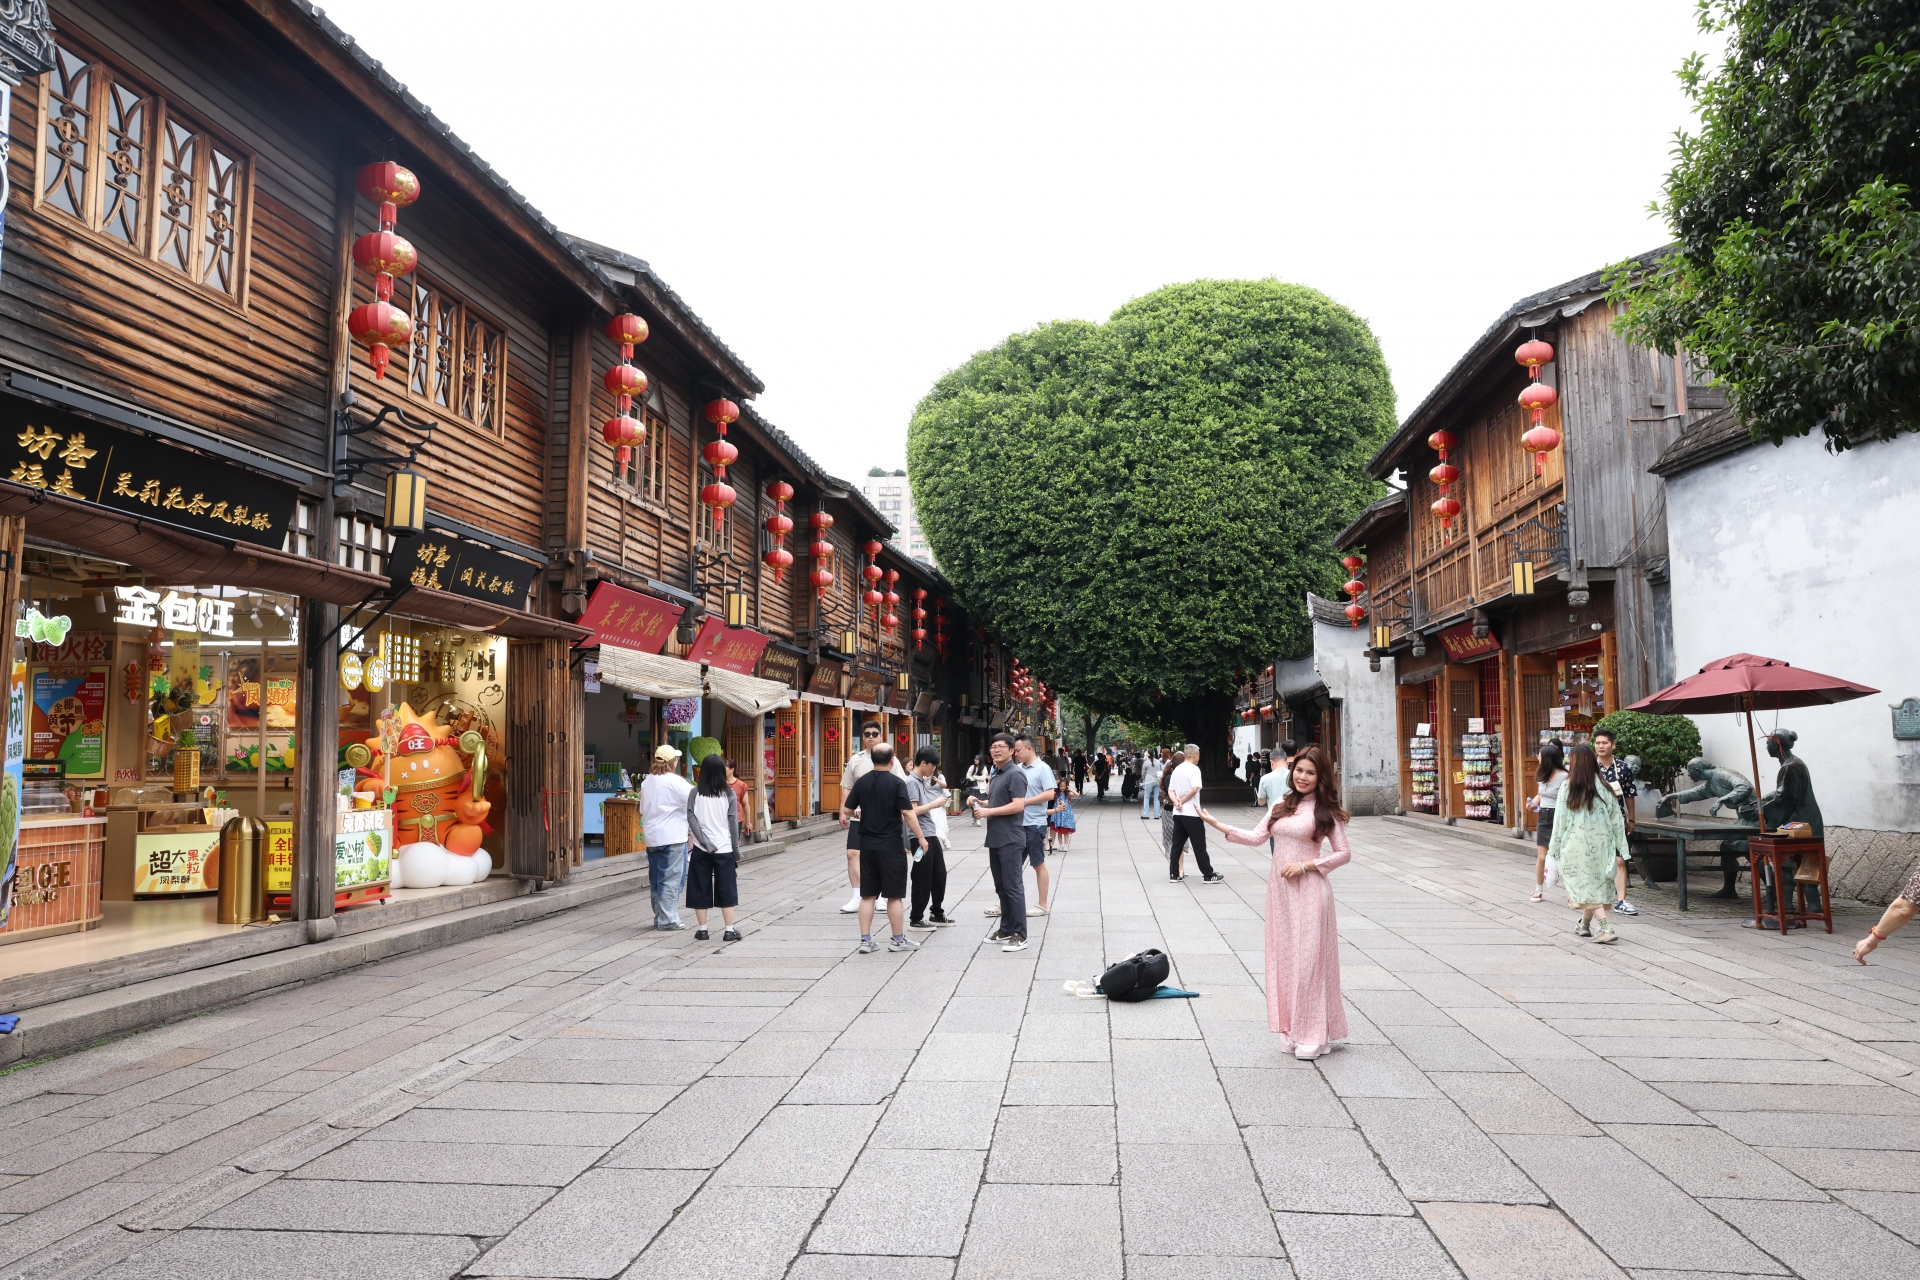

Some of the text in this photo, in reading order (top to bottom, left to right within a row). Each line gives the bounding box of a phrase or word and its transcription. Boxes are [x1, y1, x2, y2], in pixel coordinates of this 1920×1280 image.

[17, 424, 98, 469] 坊巷
[9, 461, 87, 501] 福来
[112, 471, 273, 532] 茉莉花茶凤梨酥
[417, 542, 451, 568] 坊巷
[114, 585, 236, 638] 金包旺
[37, 637, 106, 662] 消火栓
[115, 769, 138, 780] 消火栓
[160, 874, 191, 885] 凤梨酥
